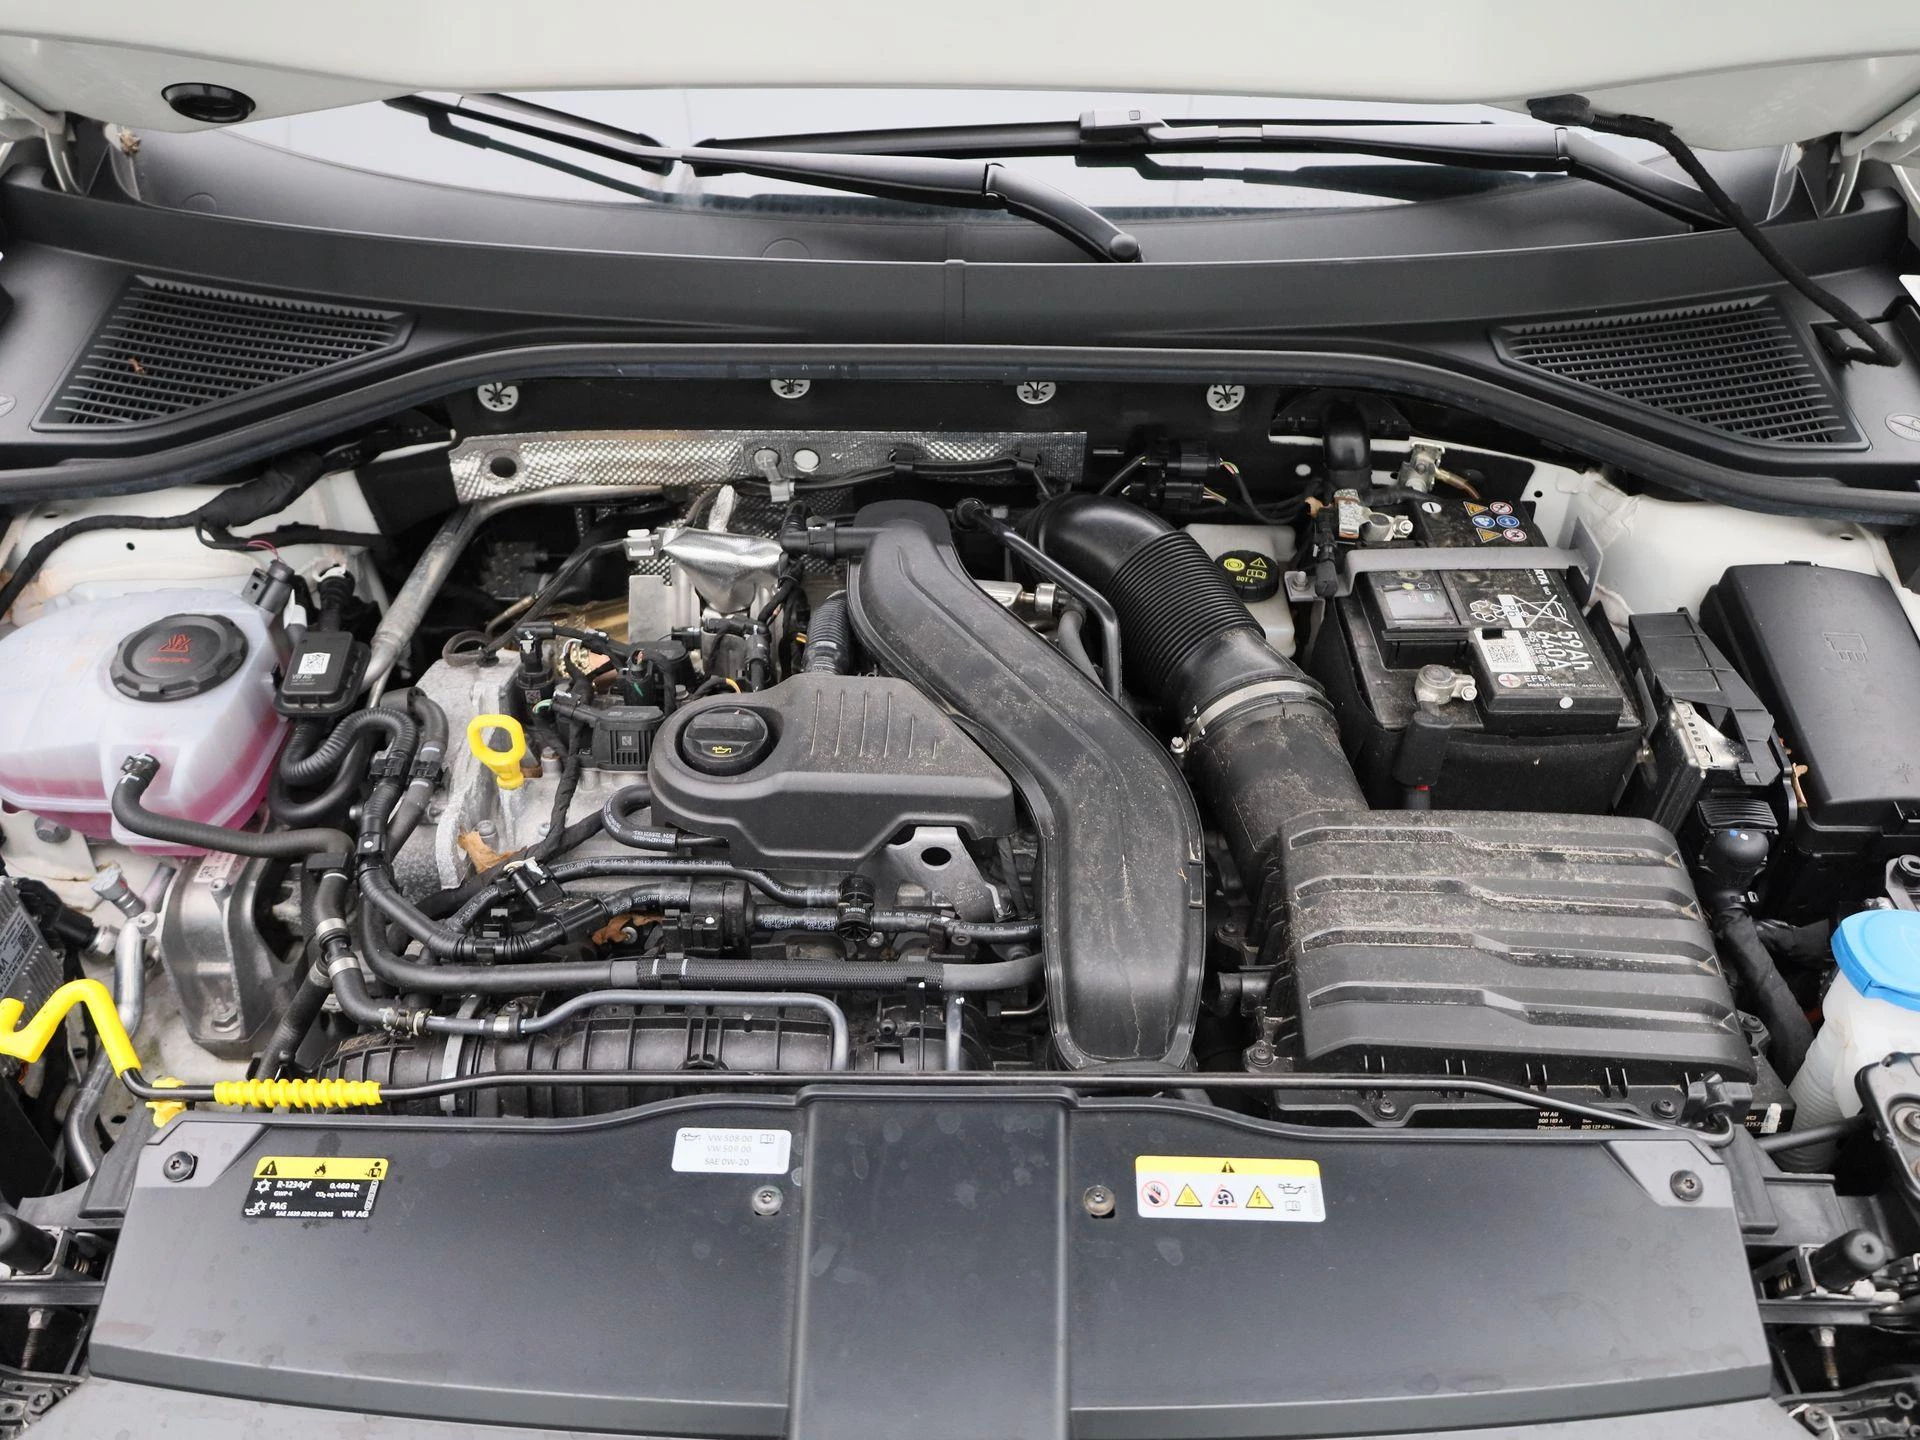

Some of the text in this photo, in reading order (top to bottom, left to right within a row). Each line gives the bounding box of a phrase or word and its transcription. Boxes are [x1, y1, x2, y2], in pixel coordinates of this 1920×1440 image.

[1236, 575, 1248, 583] DOT
[1536, 631, 1572, 670] 640A
[1557, 631, 1593, 671] 59Ah
[1523, 675, 1553, 683] EFB+
[705, 1158, 719, 1166] SAE
[276, 1180, 313, 1191] R-1234yf
[329, 1182, 351, 1190] 0.460
[269, 1202, 288, 1210] PAG
[342, 1210, 370, 1218] VW AG
